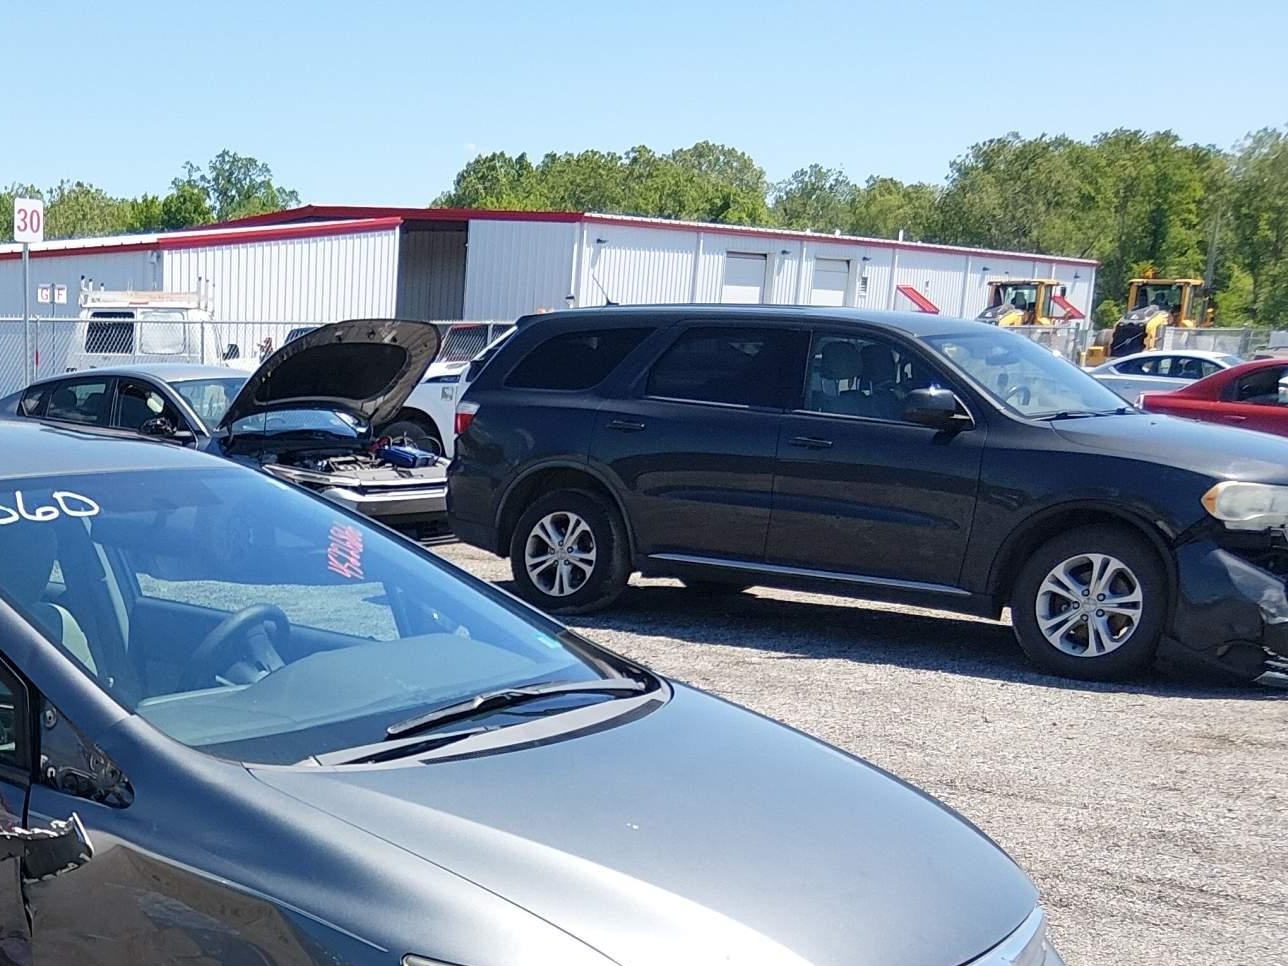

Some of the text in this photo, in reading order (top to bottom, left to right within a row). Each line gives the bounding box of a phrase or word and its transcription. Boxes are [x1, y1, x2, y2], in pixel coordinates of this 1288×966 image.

[16, 208, 41, 233] 30
[40, 287, 49, 301] G
[57, 287, 65, 301] F
